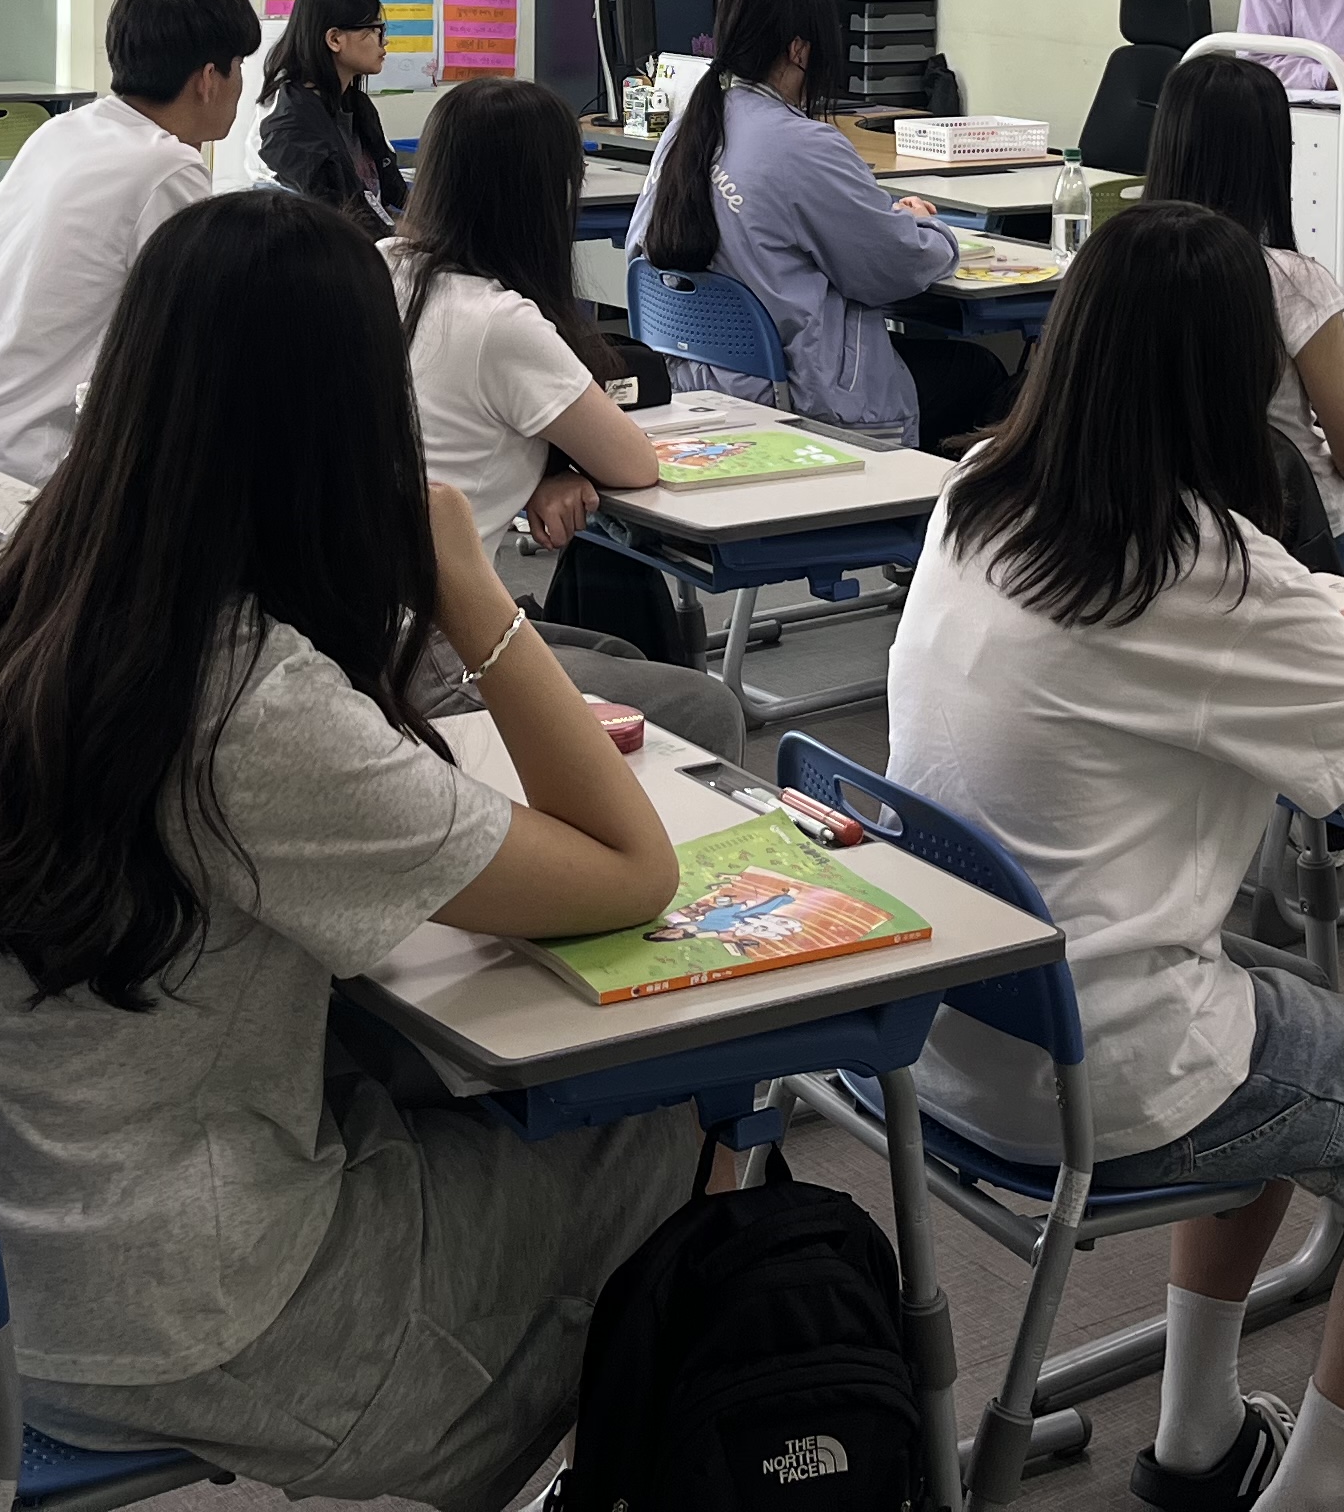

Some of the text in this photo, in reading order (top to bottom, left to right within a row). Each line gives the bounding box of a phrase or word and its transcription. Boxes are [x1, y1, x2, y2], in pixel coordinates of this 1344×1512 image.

[785, 1435, 816, 1454] THE
[762, 1449, 817, 1475] NORTH
[779, 1462, 819, 1484] FACE
